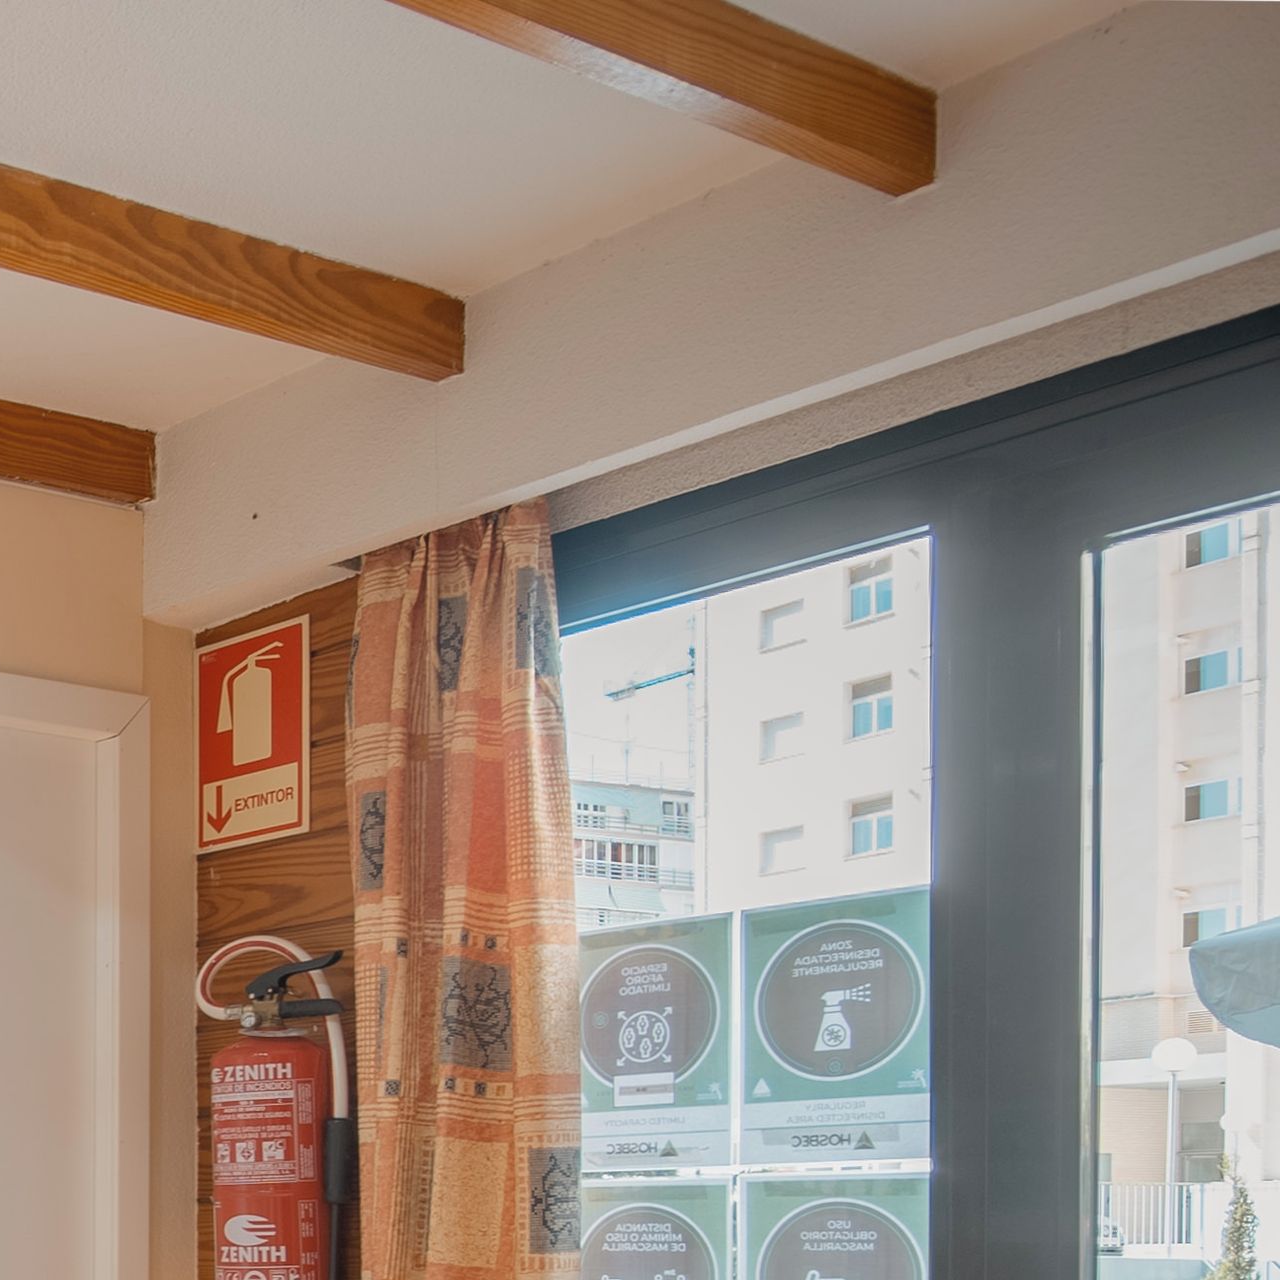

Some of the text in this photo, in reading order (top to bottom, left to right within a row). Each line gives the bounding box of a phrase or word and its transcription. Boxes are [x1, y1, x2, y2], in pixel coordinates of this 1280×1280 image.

[234, 787, 295, 812] EXTINTOR
[224, 1062, 292, 1082] ZENITH
[221, 1246, 287, 1262] ZENITH
